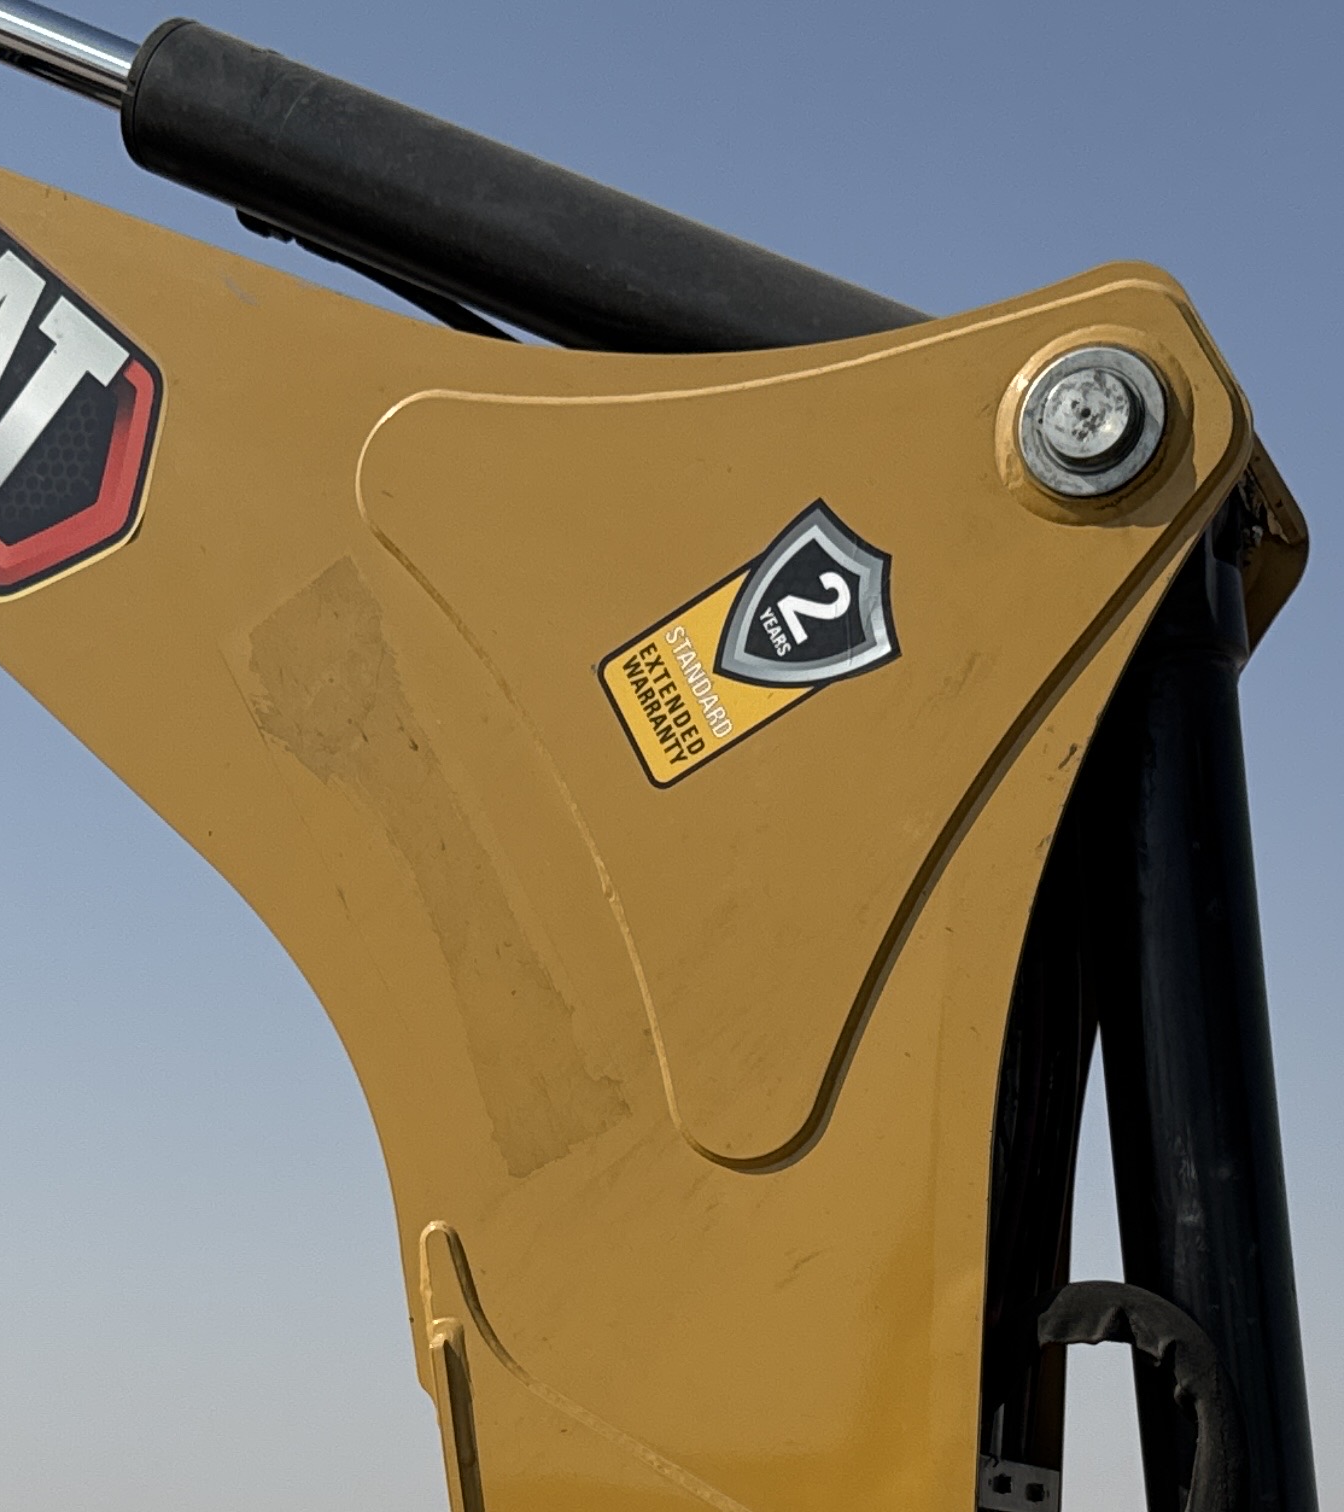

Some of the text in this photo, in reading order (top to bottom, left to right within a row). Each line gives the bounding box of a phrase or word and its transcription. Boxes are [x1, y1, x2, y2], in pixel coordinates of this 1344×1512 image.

[759, 606, 792, 658] YEARS
[776, 571, 852, 646] 2
[622, 653, 689, 766] WARRANTY
[639, 641, 706, 757] EXTENDED
[665, 625, 733, 739] STANDARD
